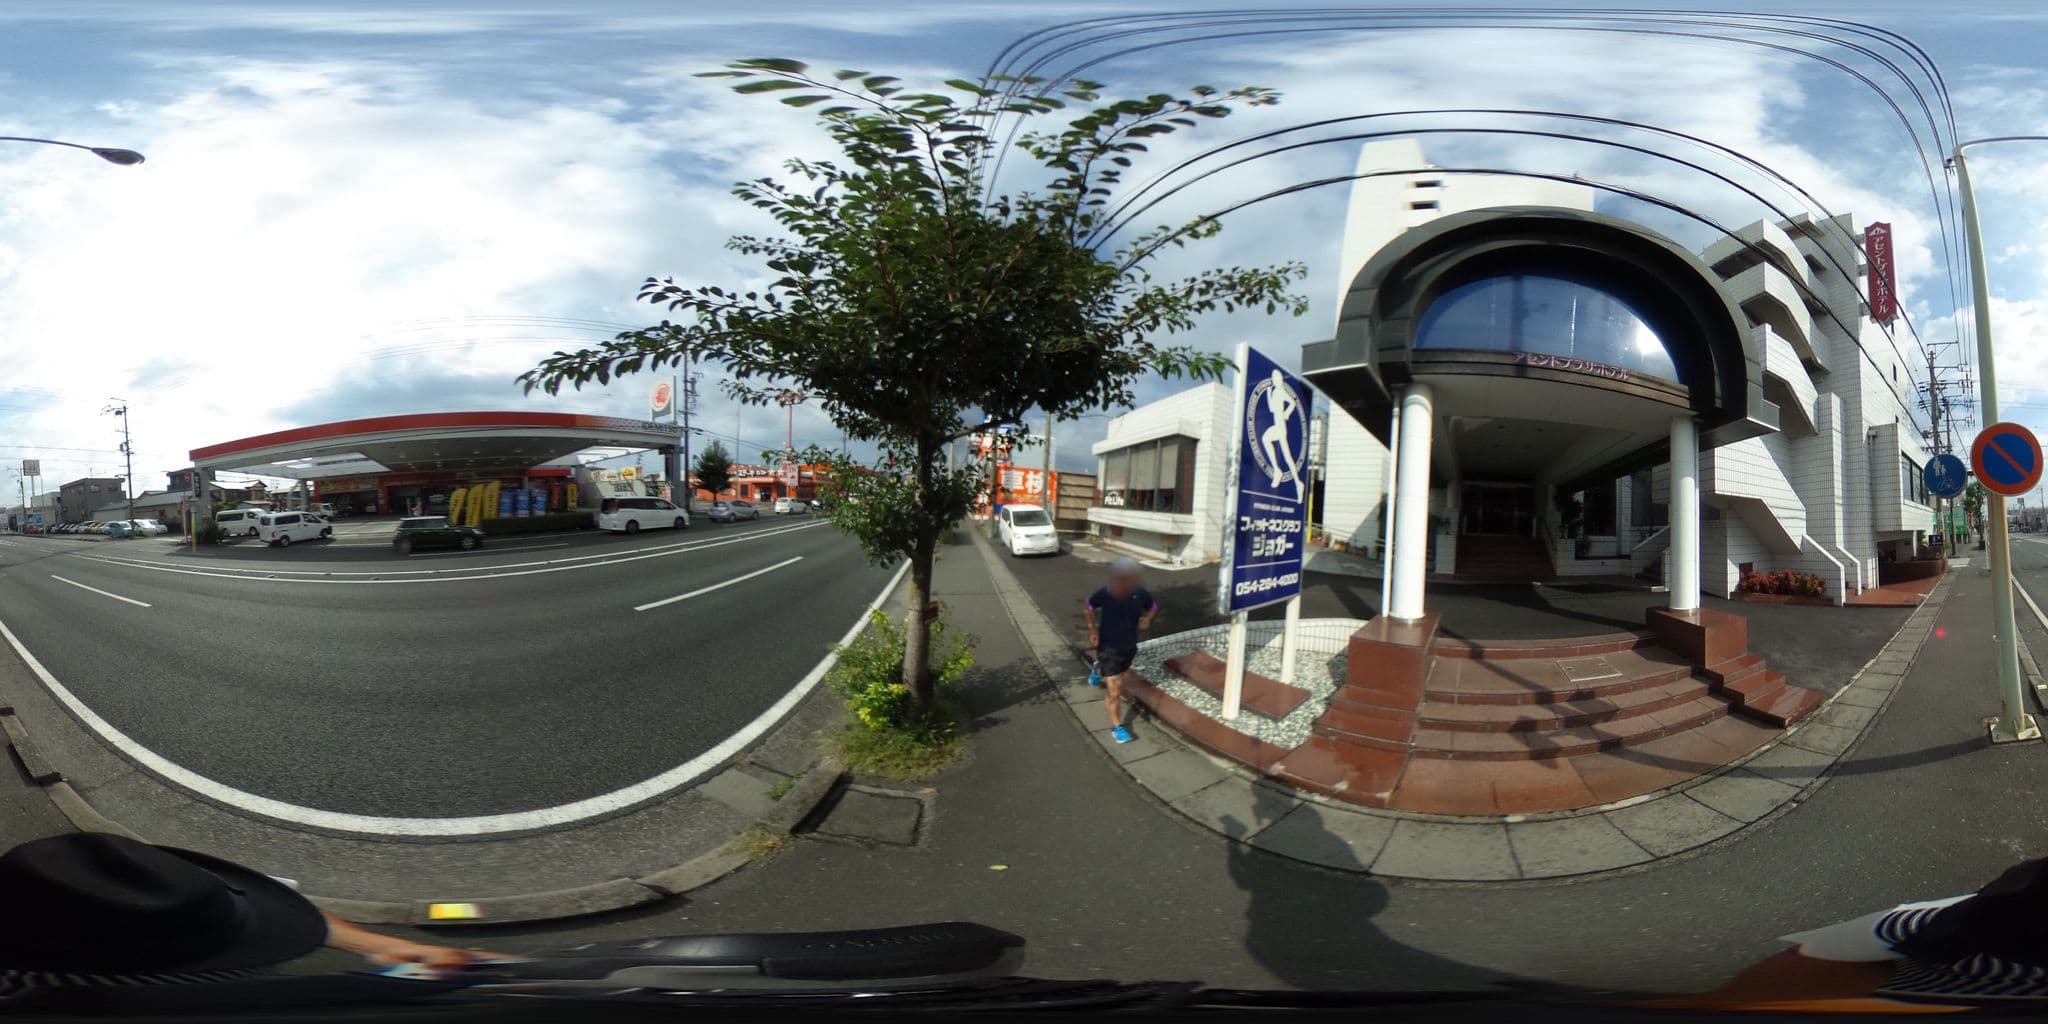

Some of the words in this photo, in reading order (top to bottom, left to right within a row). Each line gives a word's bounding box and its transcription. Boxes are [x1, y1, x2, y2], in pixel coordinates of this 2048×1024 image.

[1512, 352, 1630, 379] アセントプラザホテル
[1252, 533, 1294, 557] ジョガー
